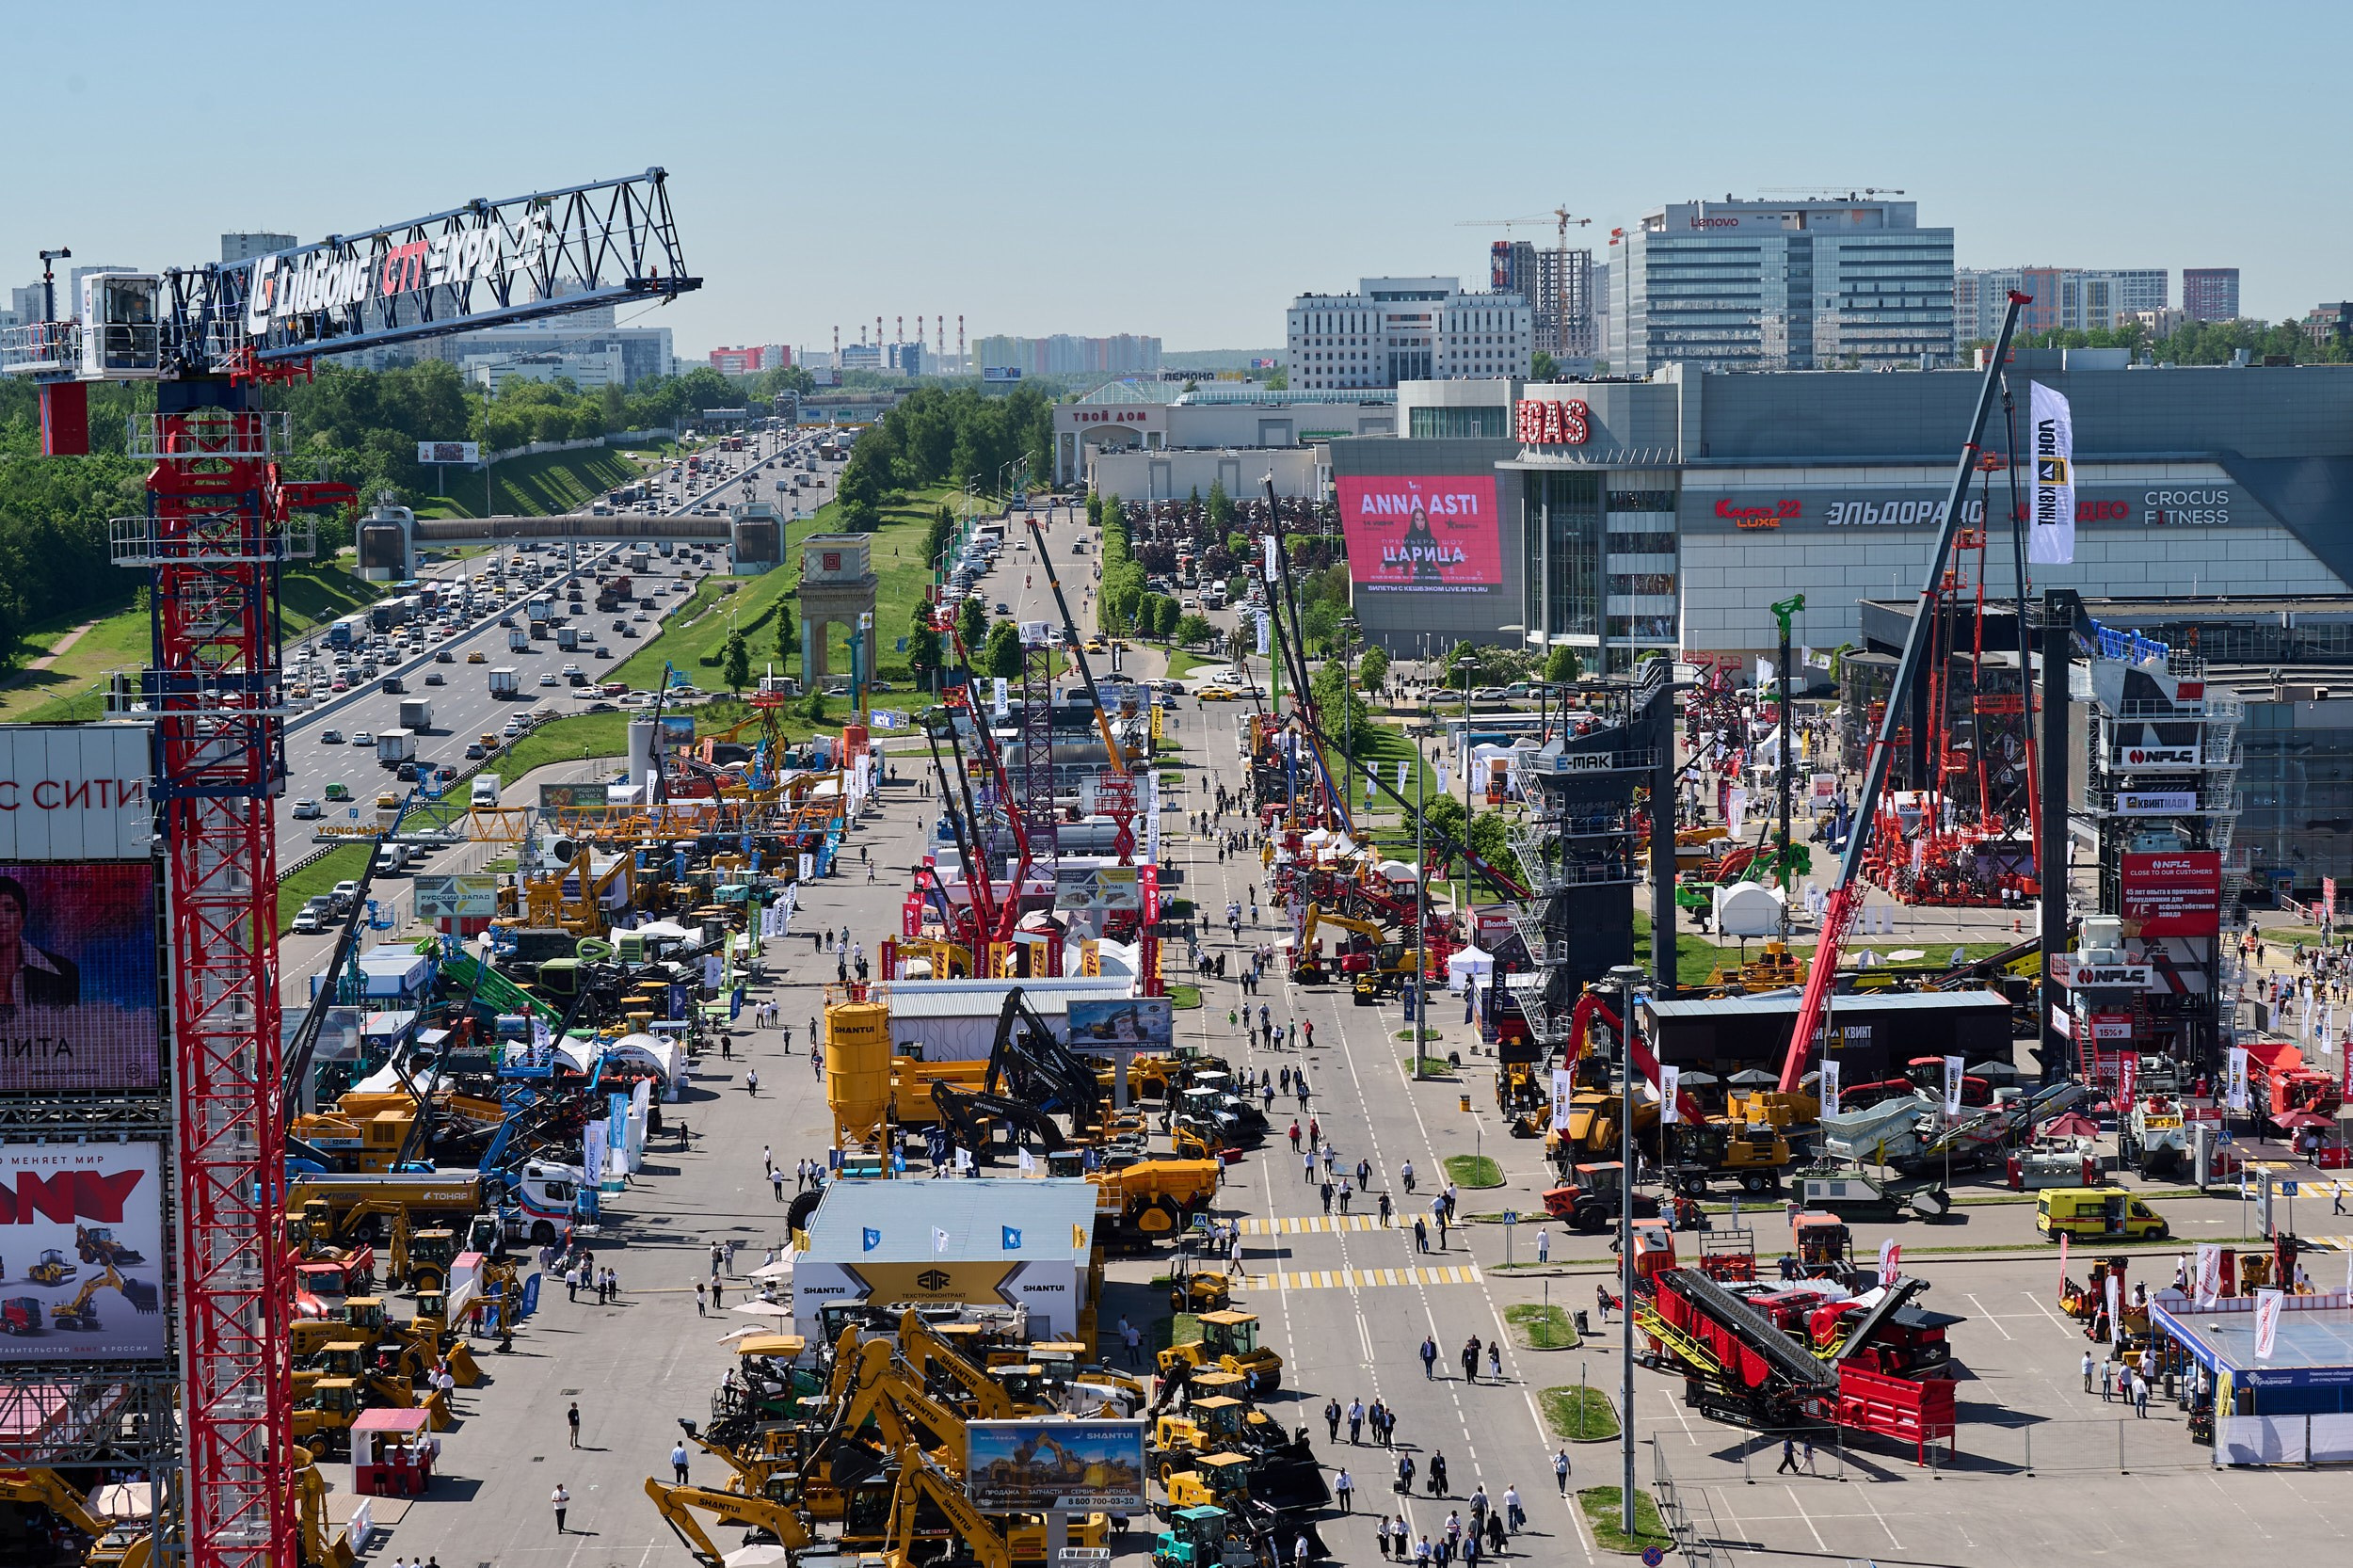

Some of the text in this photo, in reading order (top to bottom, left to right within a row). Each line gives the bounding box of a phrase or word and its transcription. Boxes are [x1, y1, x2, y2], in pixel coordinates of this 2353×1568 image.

[1691, 216, 1739, 227] Lenovo
[382, 240, 430, 296] CTT
[1163, 372, 1214, 381] ЛЕМАНА
[1073, 410, 1146, 423] ТВОЙ ДОМ
[1361, 493, 1478, 515] ANNA ASTI
[2144, 490, 2229, 505] CROCUS
[1778, 500, 1801, 517] 22
[1827, 501, 1983, 525] ЭЛЬДОРАО
[1736, 519, 1781, 528] LUXE
[1384, 547, 1466, 563] ЦАРИЦА
[1556, 755, 1610, 771] E-MAK
[2145, 750, 2193, 763] NFLG
[33, 779, 144, 809] СИТИ
[317, 826, 353, 836] YONG
[2162, 860, 2191, 869] NFLG
[2094, 969, 2146, 983] NFLG
[1495, 971, 1505, 1004] FABO
[834, 1026, 874, 1034] SHANTUI
[1844, 1026, 1872, 1039] КВИНТ
[2099, 1029, 2117, 1037] 15%
[1048, 1048, 1066, 1073] HYUNDAI
[1033, 1069, 1059, 1091] HYUNDAI
[974, 1101, 1003, 1114] HYUNDAI
[11, 1157, 68, 1165] МЕНЯЕТ
[433, 1192, 468, 1200] ТОНАР
[1023, 1284, 1064, 1292] SHANTUI
[940, 1355, 978, 1388] SHANTUI
[2257, 1378, 2292, 1386] Традиция
[904, 1393, 938, 1424] SHANTUI
[698, 1497, 741, 1513] SHANTUI
[942, 1498, 972, 1532] SHANTUI
